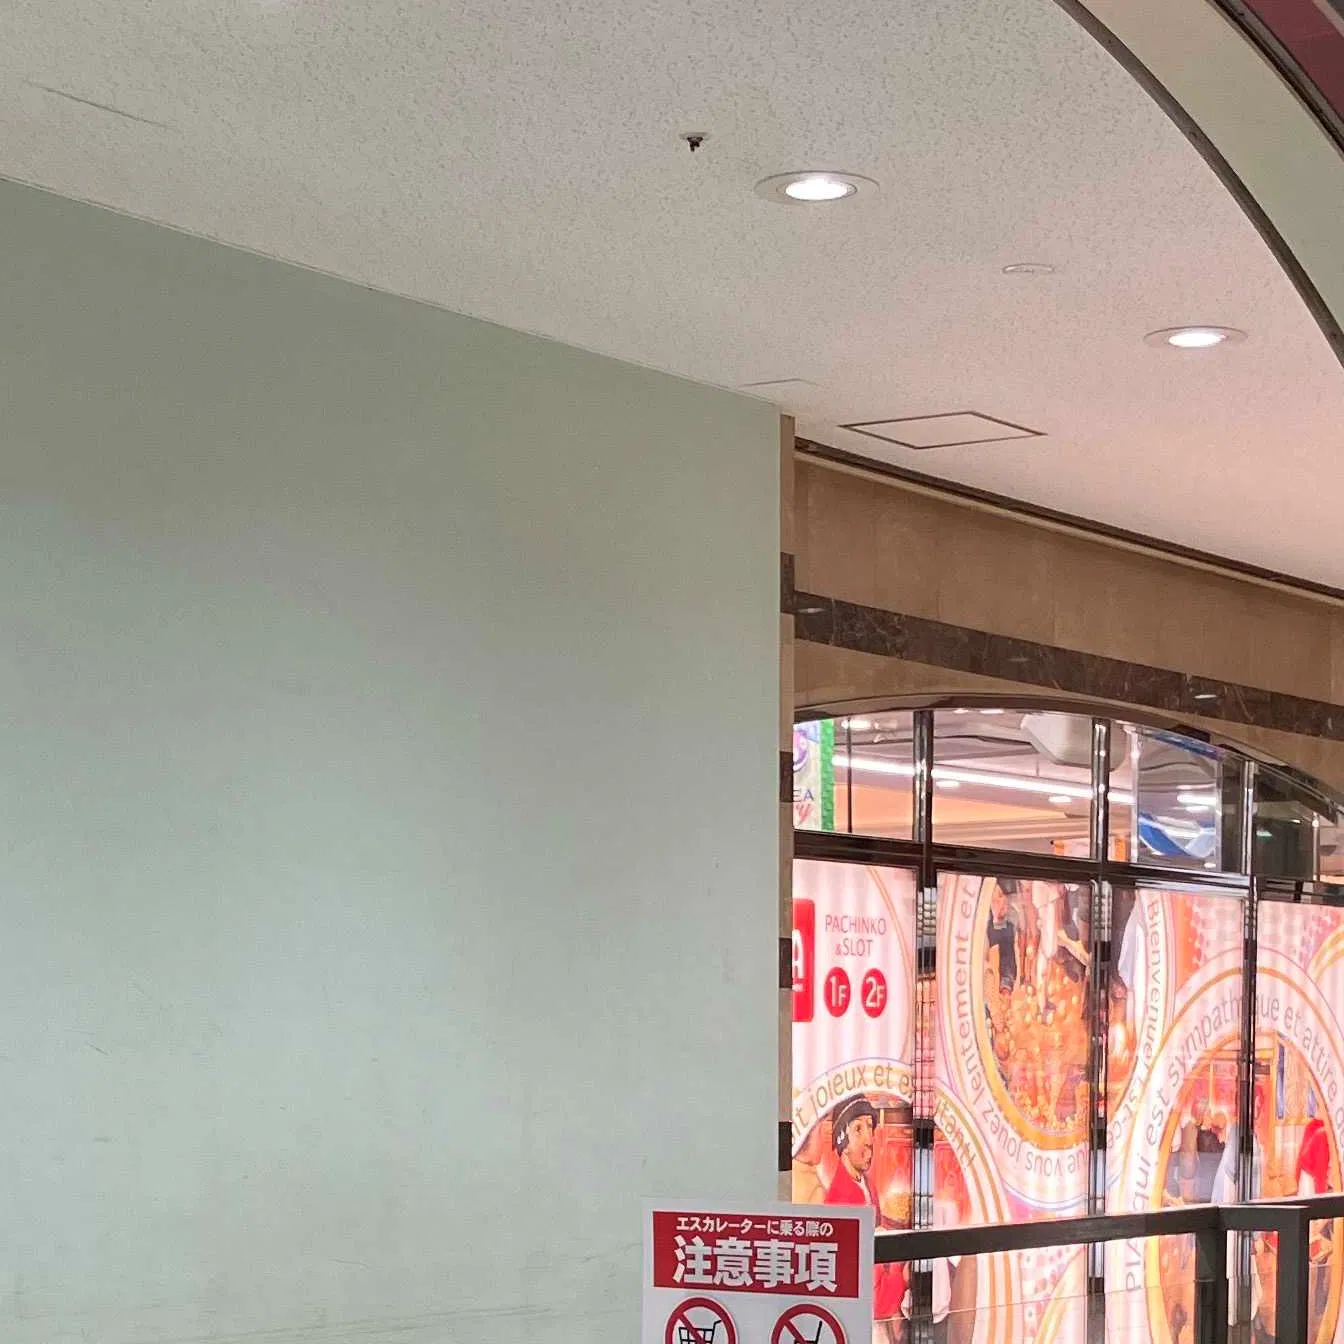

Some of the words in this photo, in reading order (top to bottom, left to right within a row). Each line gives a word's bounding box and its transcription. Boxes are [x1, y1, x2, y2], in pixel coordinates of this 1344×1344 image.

[824, 914, 887, 936] PACHINKO
[829, 976, 847, 1008] 1F
[865, 976, 886, 1008] 2F
[955, 934, 986, 1105] lentement
[1284, 1005, 1302, 1037] et
[874, 1063, 895, 1090] et
[1027, 1151, 1063, 1177] vous
[676, 1216, 834, 1237] エスカレーターに乗る際の
[672, 1234, 838, 1293] 注意事項
